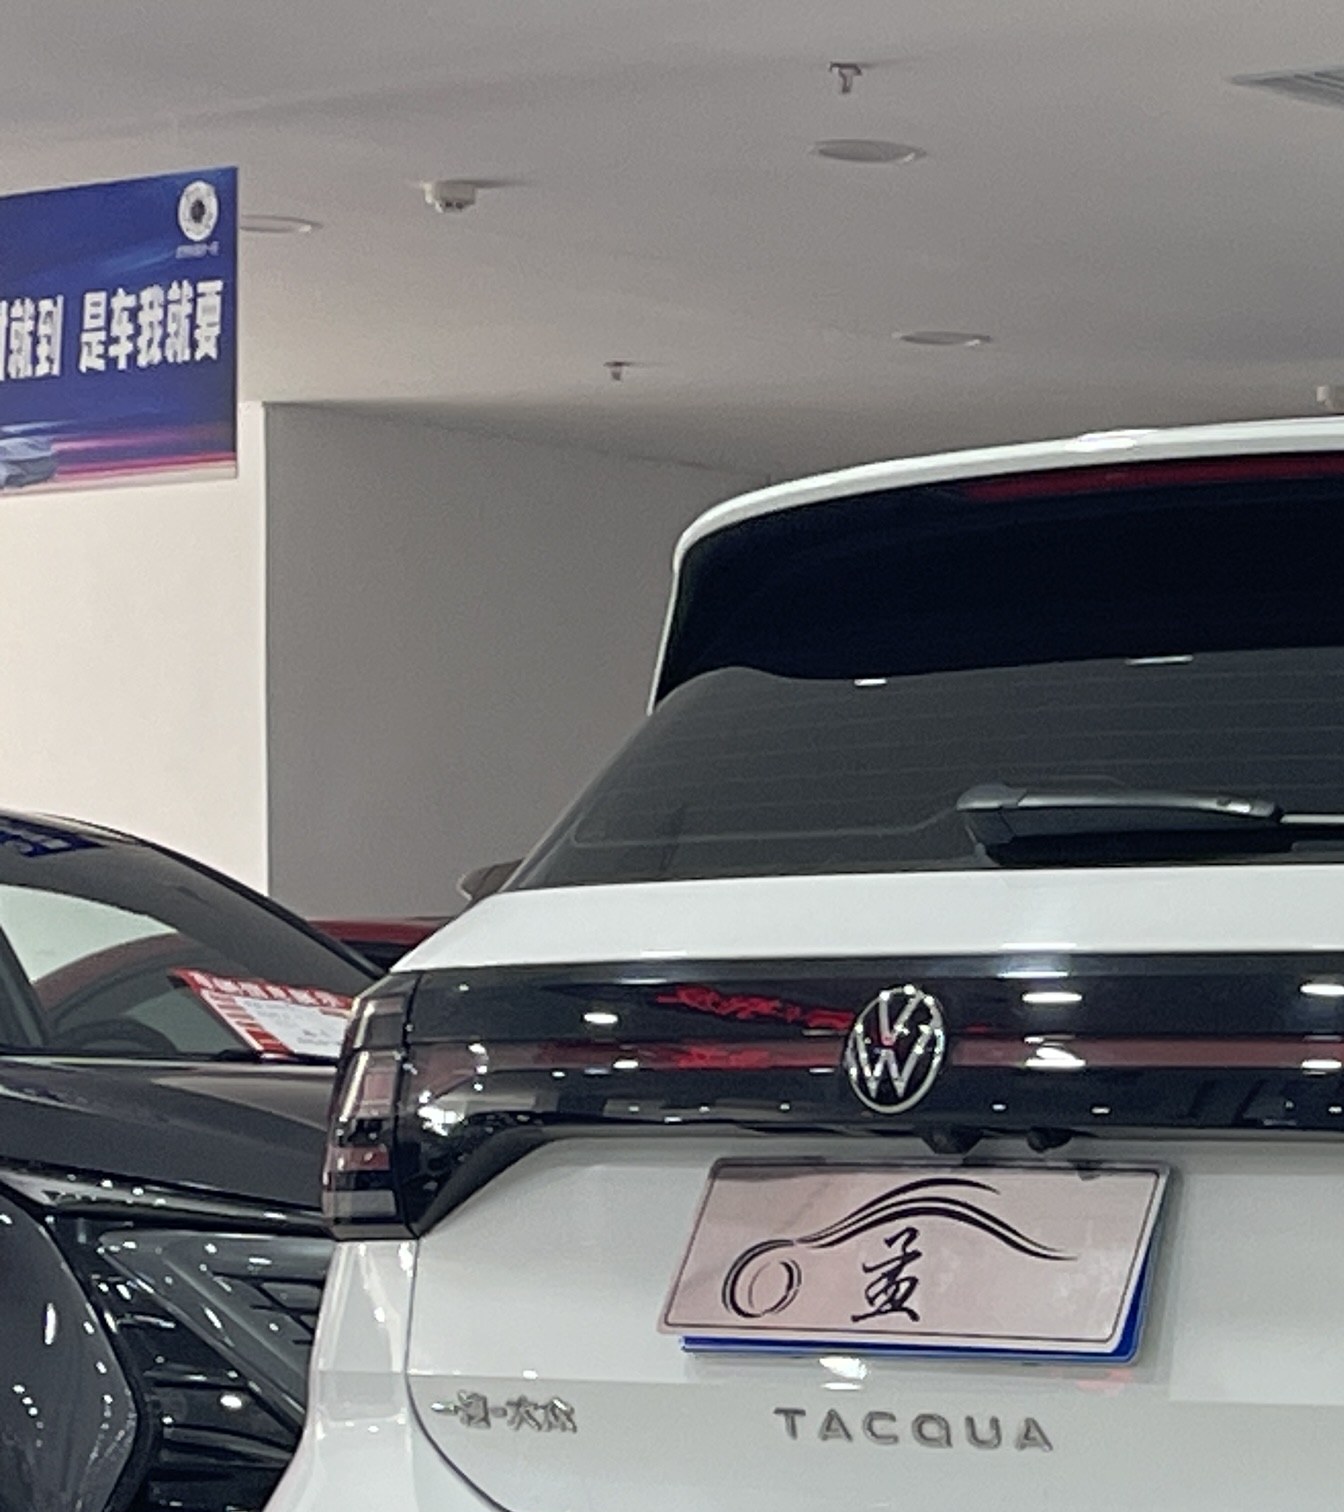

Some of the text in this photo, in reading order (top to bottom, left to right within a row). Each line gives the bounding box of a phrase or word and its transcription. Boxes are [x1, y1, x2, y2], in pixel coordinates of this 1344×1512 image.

[0, 280, 223, 380] 就到 是车我就要
[773, 1406, 1055, 1452] TACQUA
